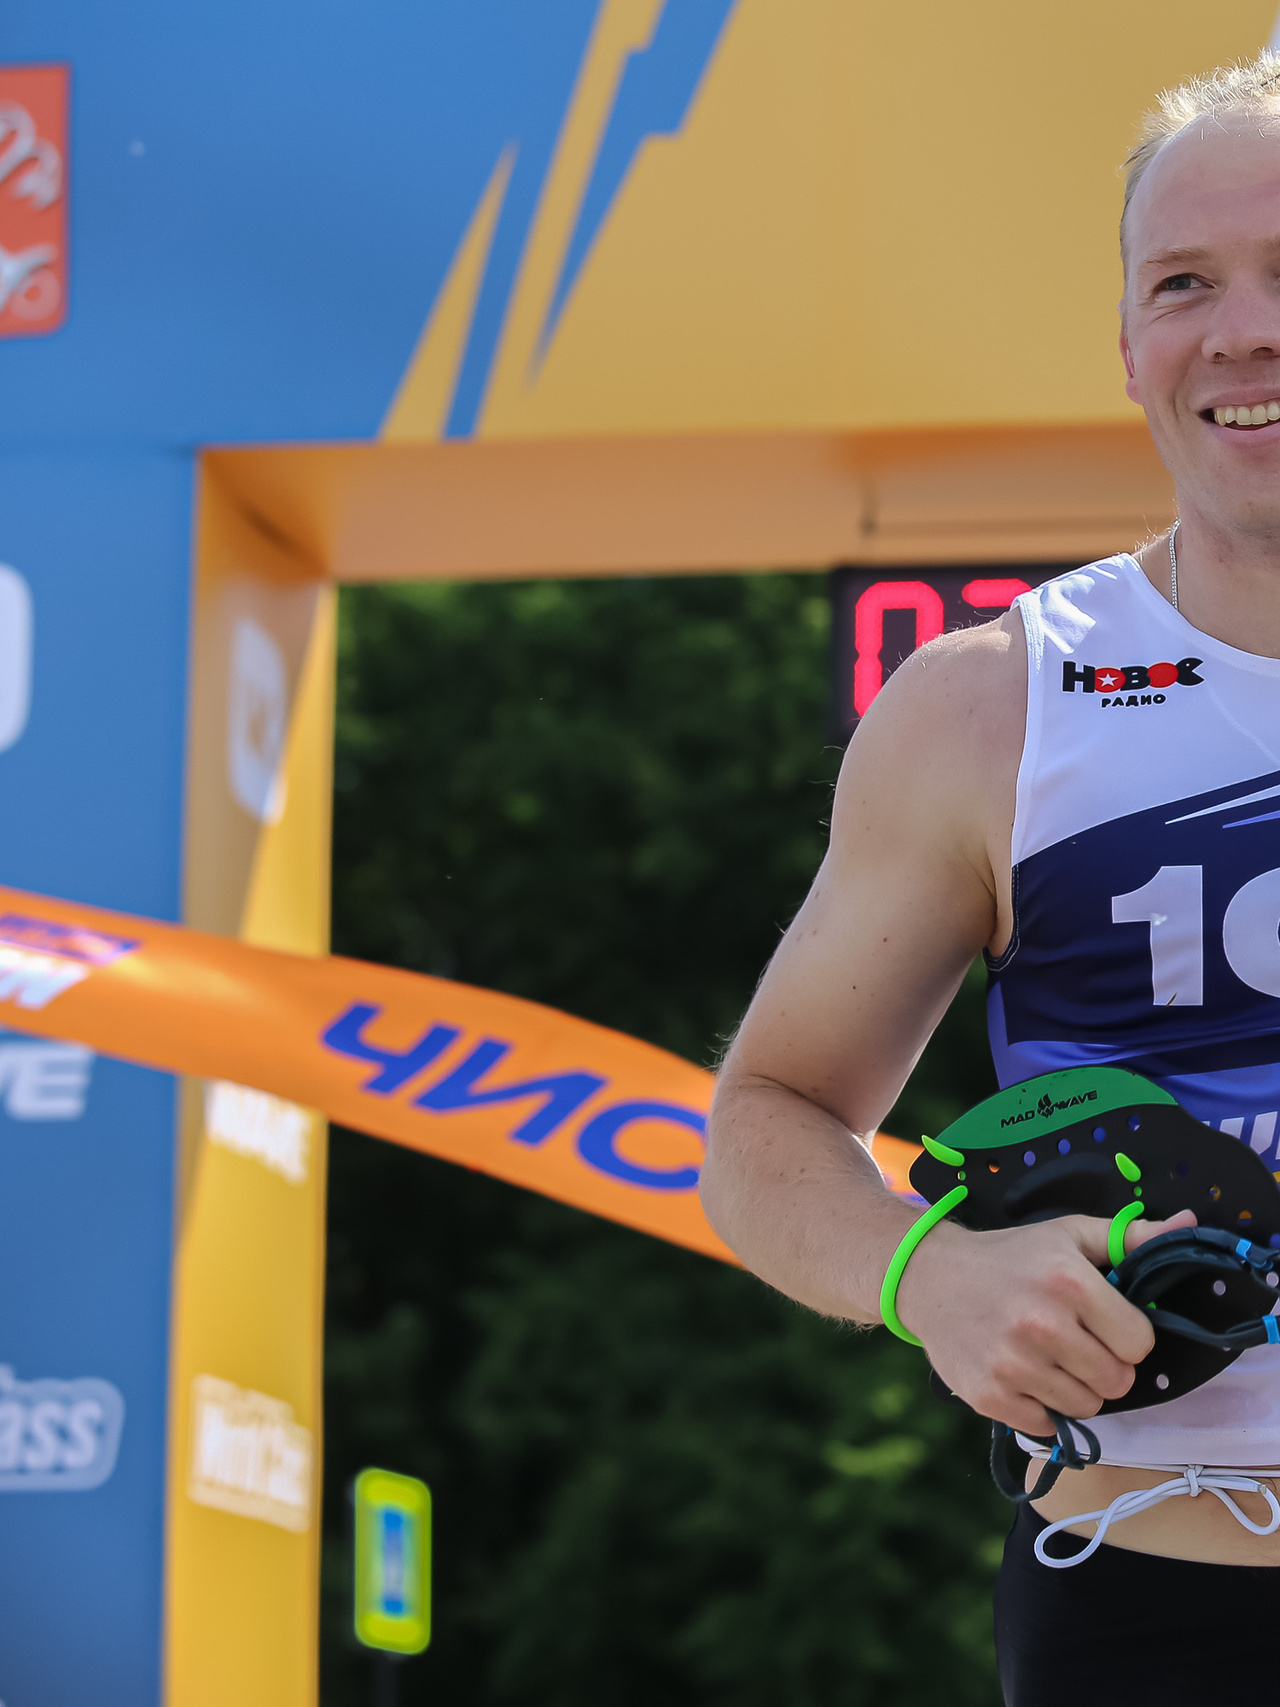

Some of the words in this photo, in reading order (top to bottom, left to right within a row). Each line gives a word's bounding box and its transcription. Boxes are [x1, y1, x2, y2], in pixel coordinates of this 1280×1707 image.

[1101, 694, 1166, 708] РАДИО
[1000, 1110, 1036, 1128] MAD
[1052, 1089, 1098, 1110] WAVE
